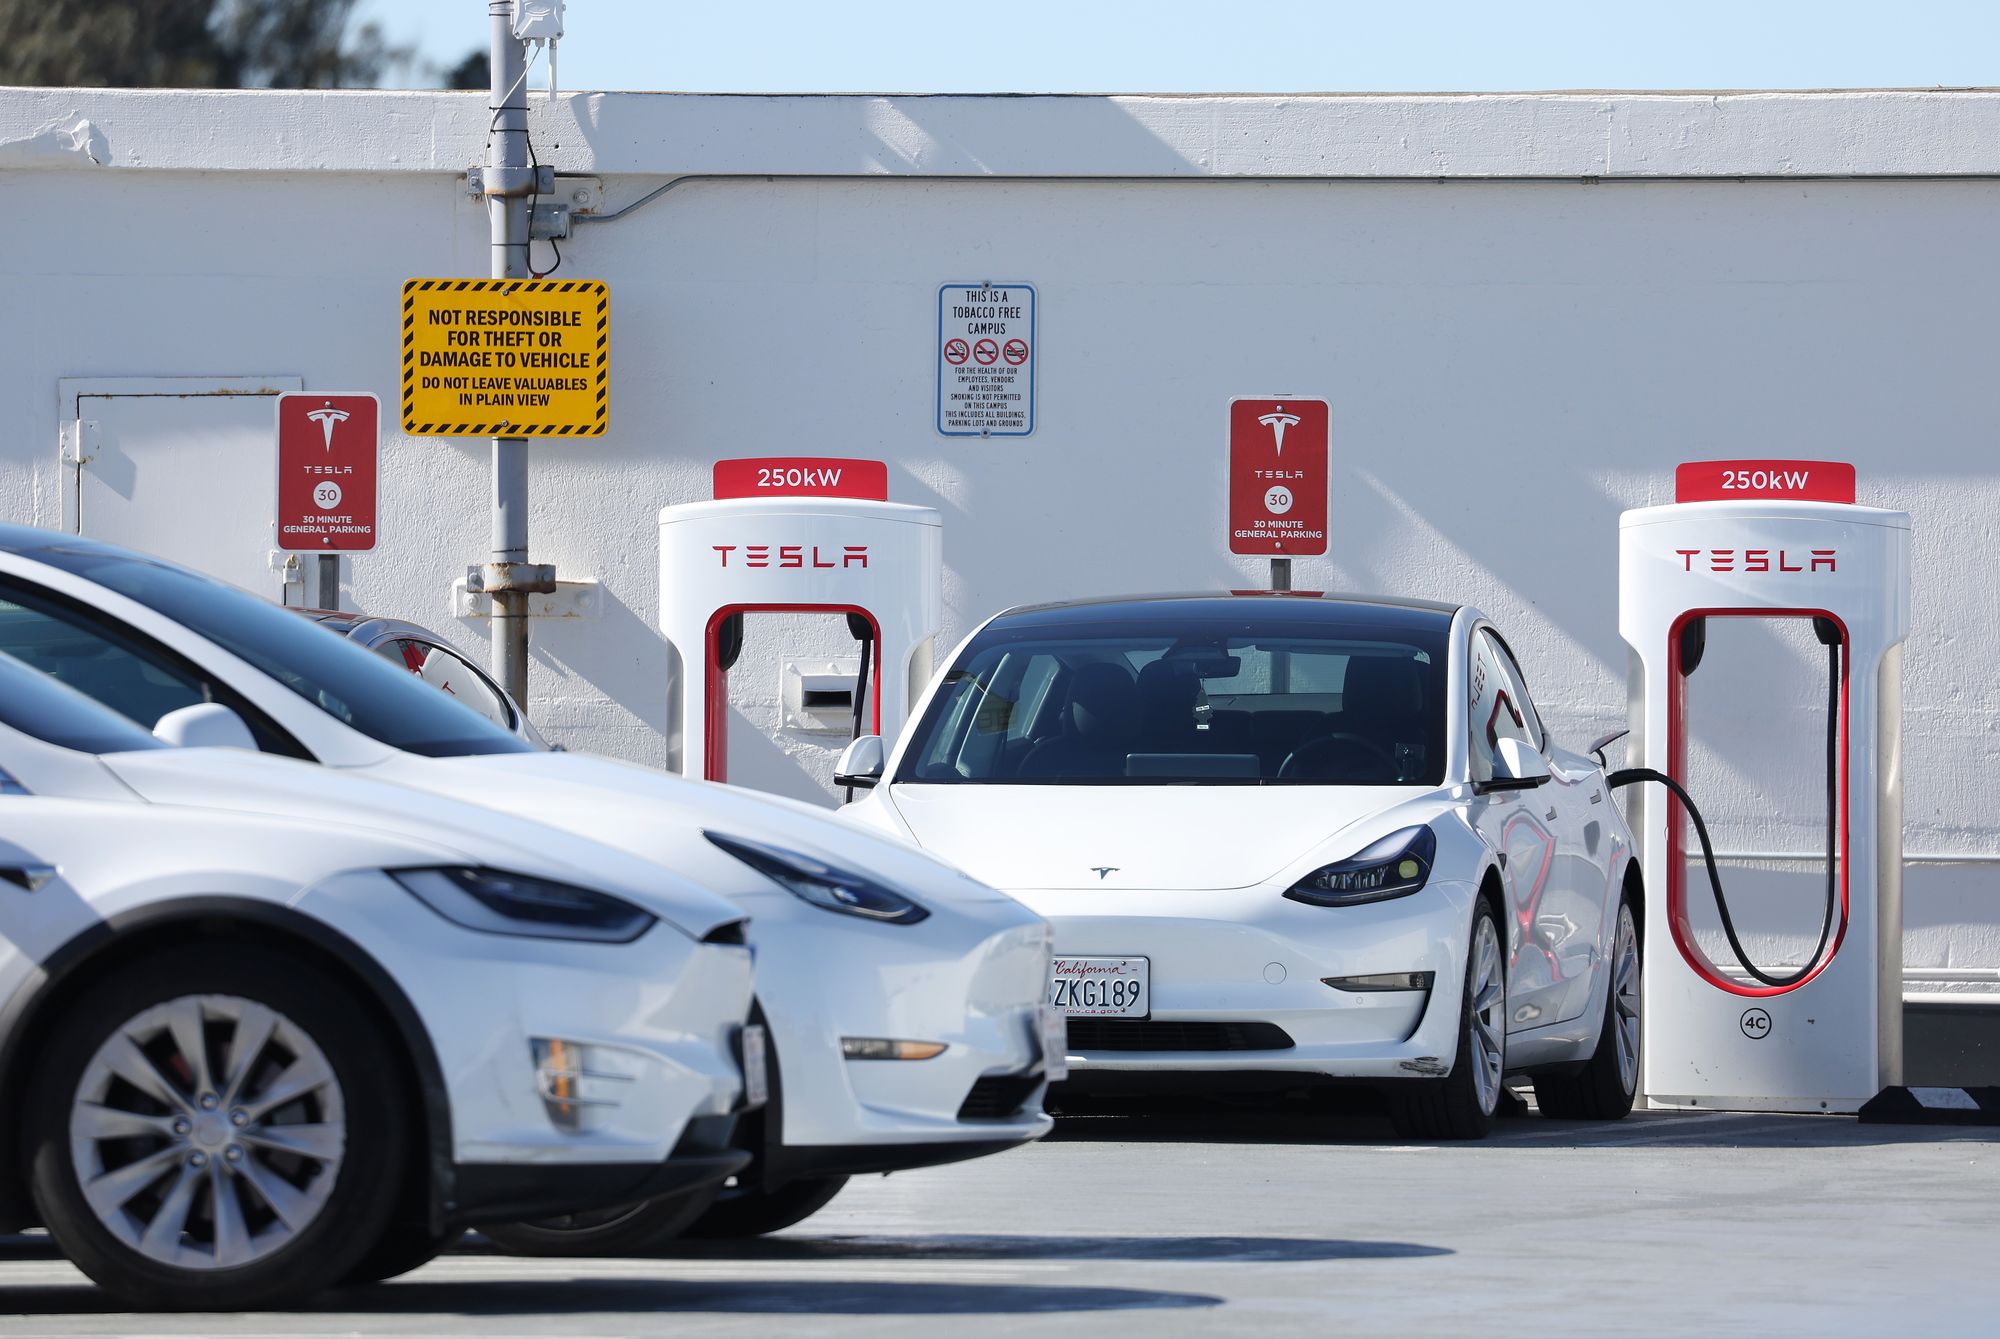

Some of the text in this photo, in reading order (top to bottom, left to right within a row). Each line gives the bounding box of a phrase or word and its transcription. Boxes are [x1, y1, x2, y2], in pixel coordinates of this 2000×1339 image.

[966, 290, 1008, 302] THIS IS A
[429, 310, 582, 326] NOT RESPONSIBLE
[953, 306, 1020, 318] TOBACCO FREE
[968, 322, 1006, 334] CAMPUS
[448, 331, 562, 347] FOR THEFT OR
[420, 352, 590, 368] DAMAGE TO VEHICLE
[422, 376, 588, 390] DO NOT LEAVE VALUABLES
[460, 394, 550, 406] IN PLAIN VIEW
[757, 467, 841, 487] 250kW
[1721, 470, 1809, 490] 250kW
[318, 490, 337, 500] 30
[1270, 494, 1288, 506] 30
[330, 526, 371, 534] PARKING
[1268, 520, 1304, 528] MINUTE
[1235, 530, 1322, 538] GENERAL PARKING
[712, 546, 868, 568] TESLA
[1676, 550, 1836, 572] TESLA
[1056, 960, 1126, 978] California
[1049, 980, 1140, 1007] ZKG189
[1745, 1016, 1766, 1030] 4C
